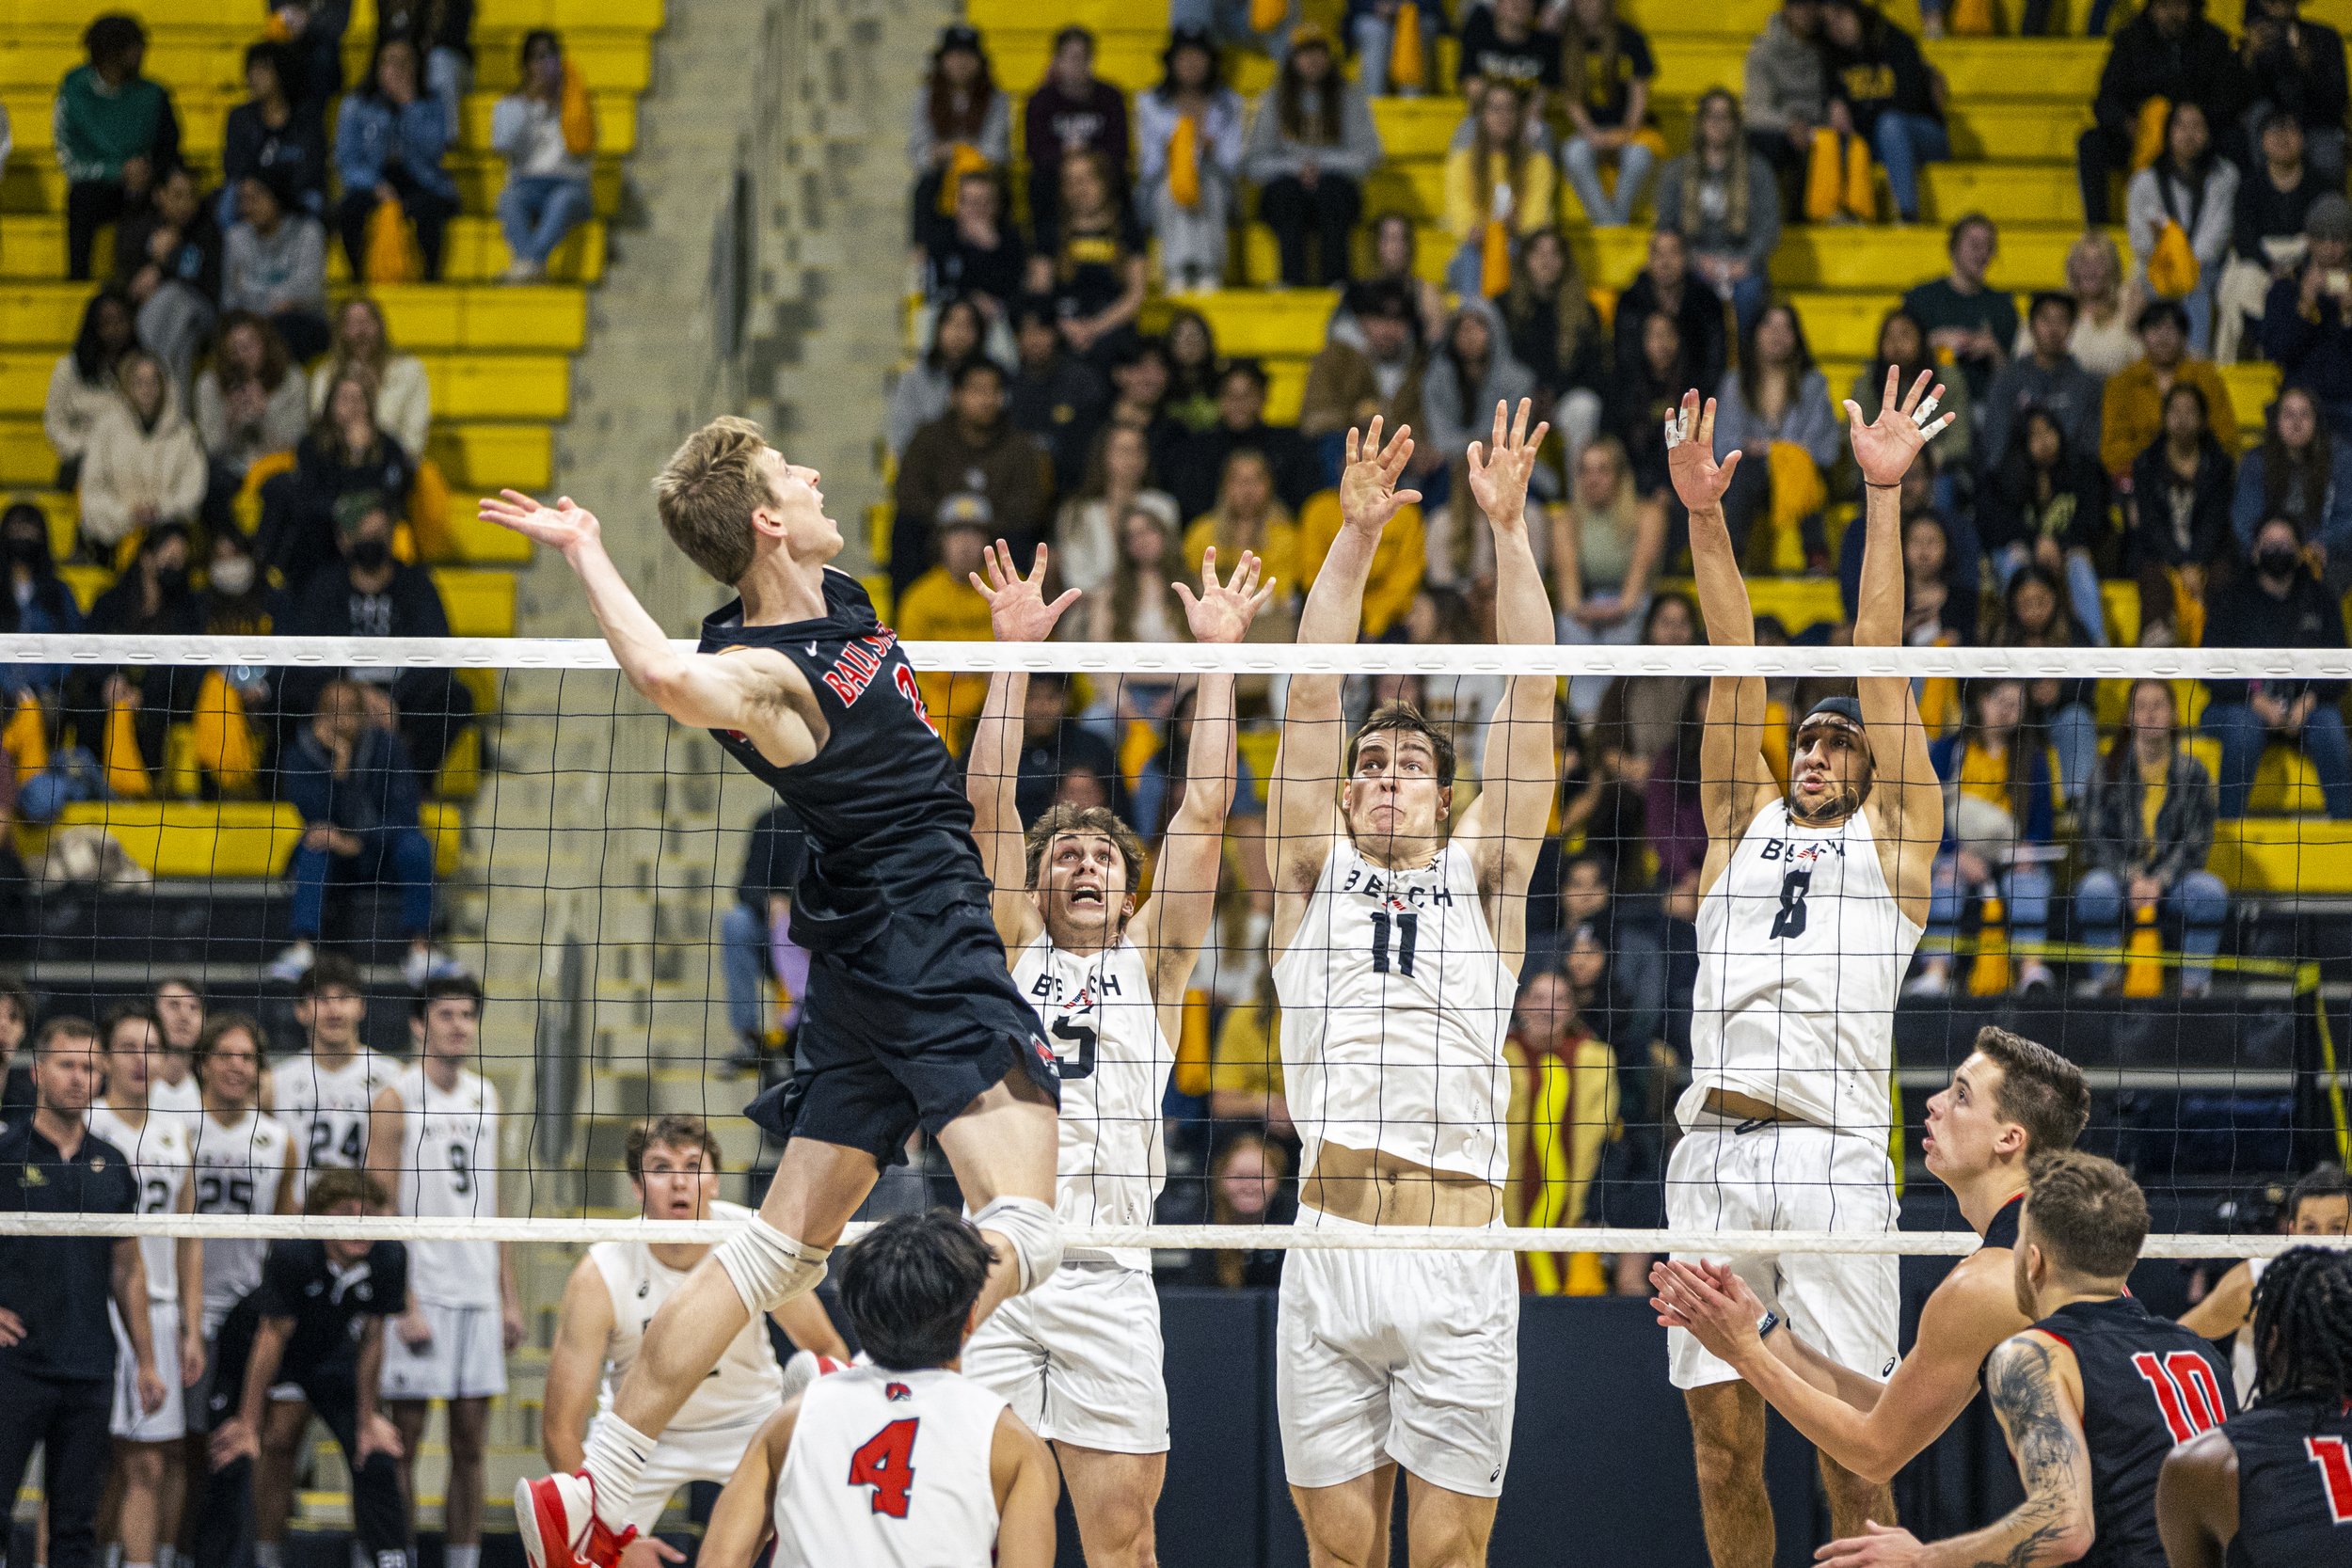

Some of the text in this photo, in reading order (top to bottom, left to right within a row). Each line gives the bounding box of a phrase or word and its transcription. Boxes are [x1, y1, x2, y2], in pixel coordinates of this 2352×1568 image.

[822, 641, 882, 708] BALL
[892, 662, 939, 738] 2
[1770, 868, 1812, 940] 8
[1370, 911, 1418, 978] 11
[1051, 1015, 1098, 1079] 5
[309, 1121, 360, 1169] 24
[448, 1142, 470, 1195] 9
[199, 1178, 253, 1214] 25
[2131, 1351, 2228, 1447] 10
[847, 1417, 920, 1519] 4
[2303, 1435, 2352, 1526] 1
